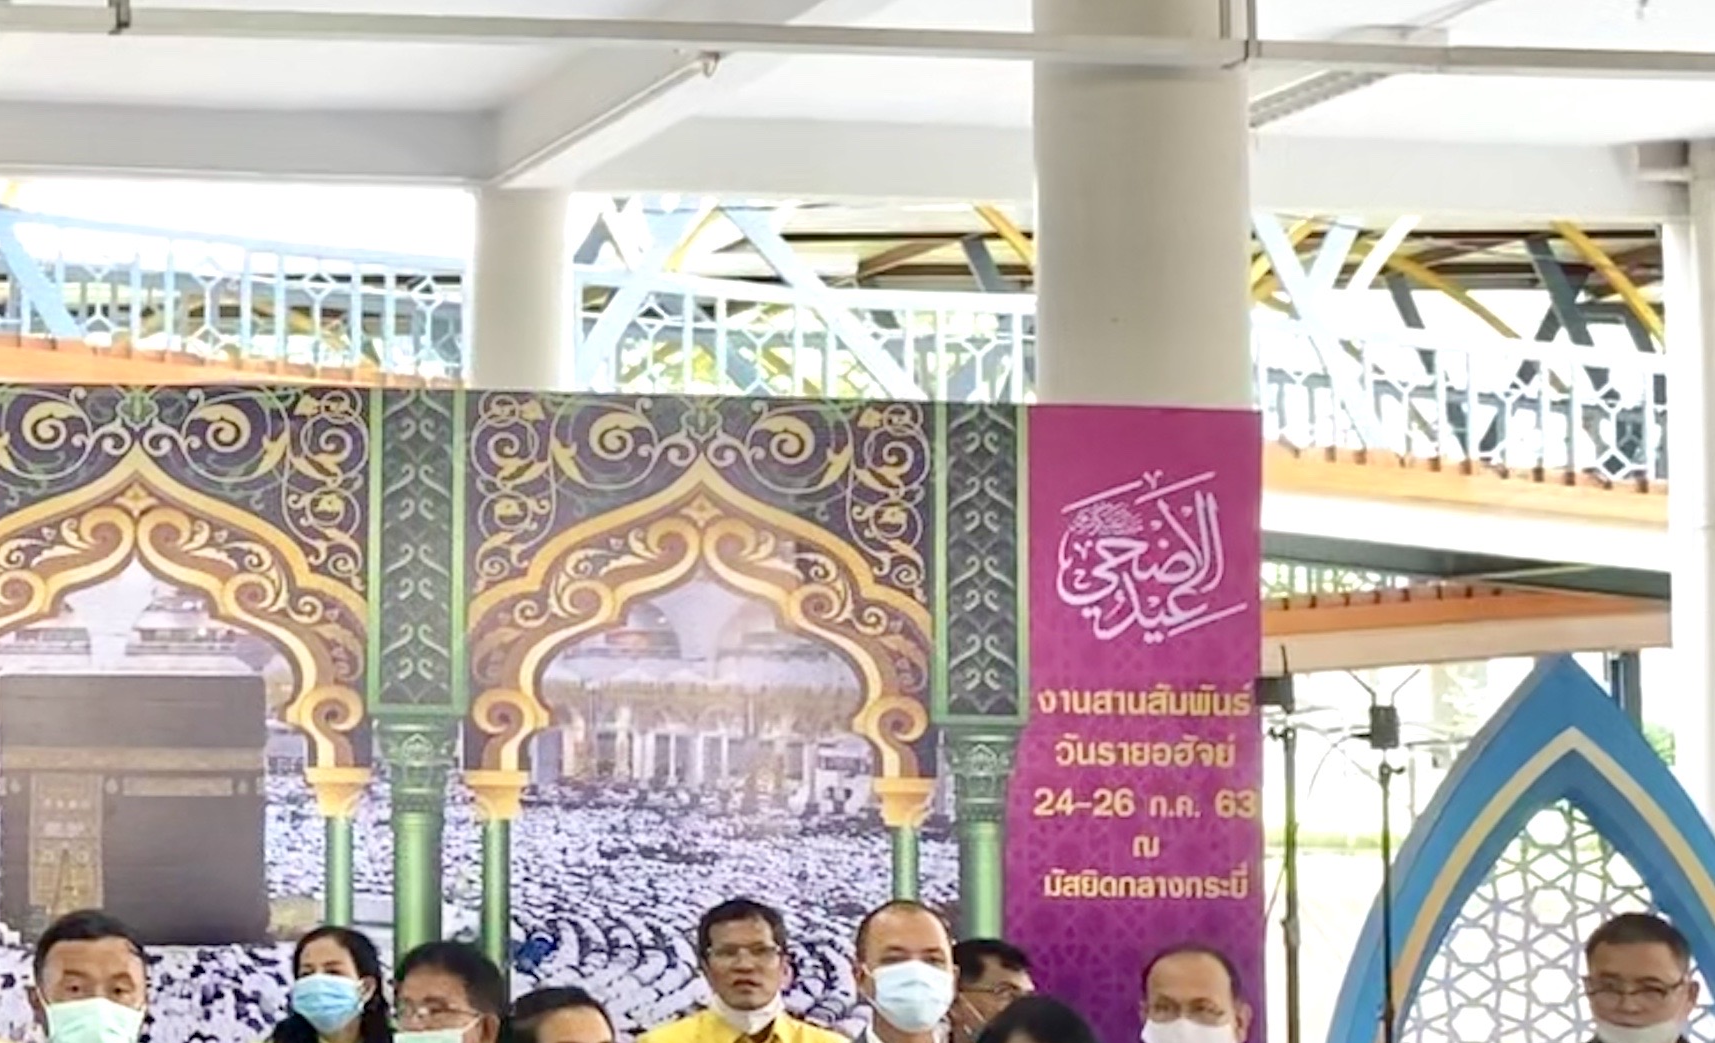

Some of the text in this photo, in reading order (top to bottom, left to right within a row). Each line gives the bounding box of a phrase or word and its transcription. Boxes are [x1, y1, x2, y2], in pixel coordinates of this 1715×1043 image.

[1037, 682, 1254, 717] งานสานสัมพันธ์
[1055, 733, 1237, 768] วันรายอฮัจย์
[1149, 795, 1202, 819] ก.ค.
[1214, 789, 1258, 819] 63
[1132, 835, 1161, 859] ณ
[1043, 862, 1249, 900] มัสยิดกลางกระบี่
